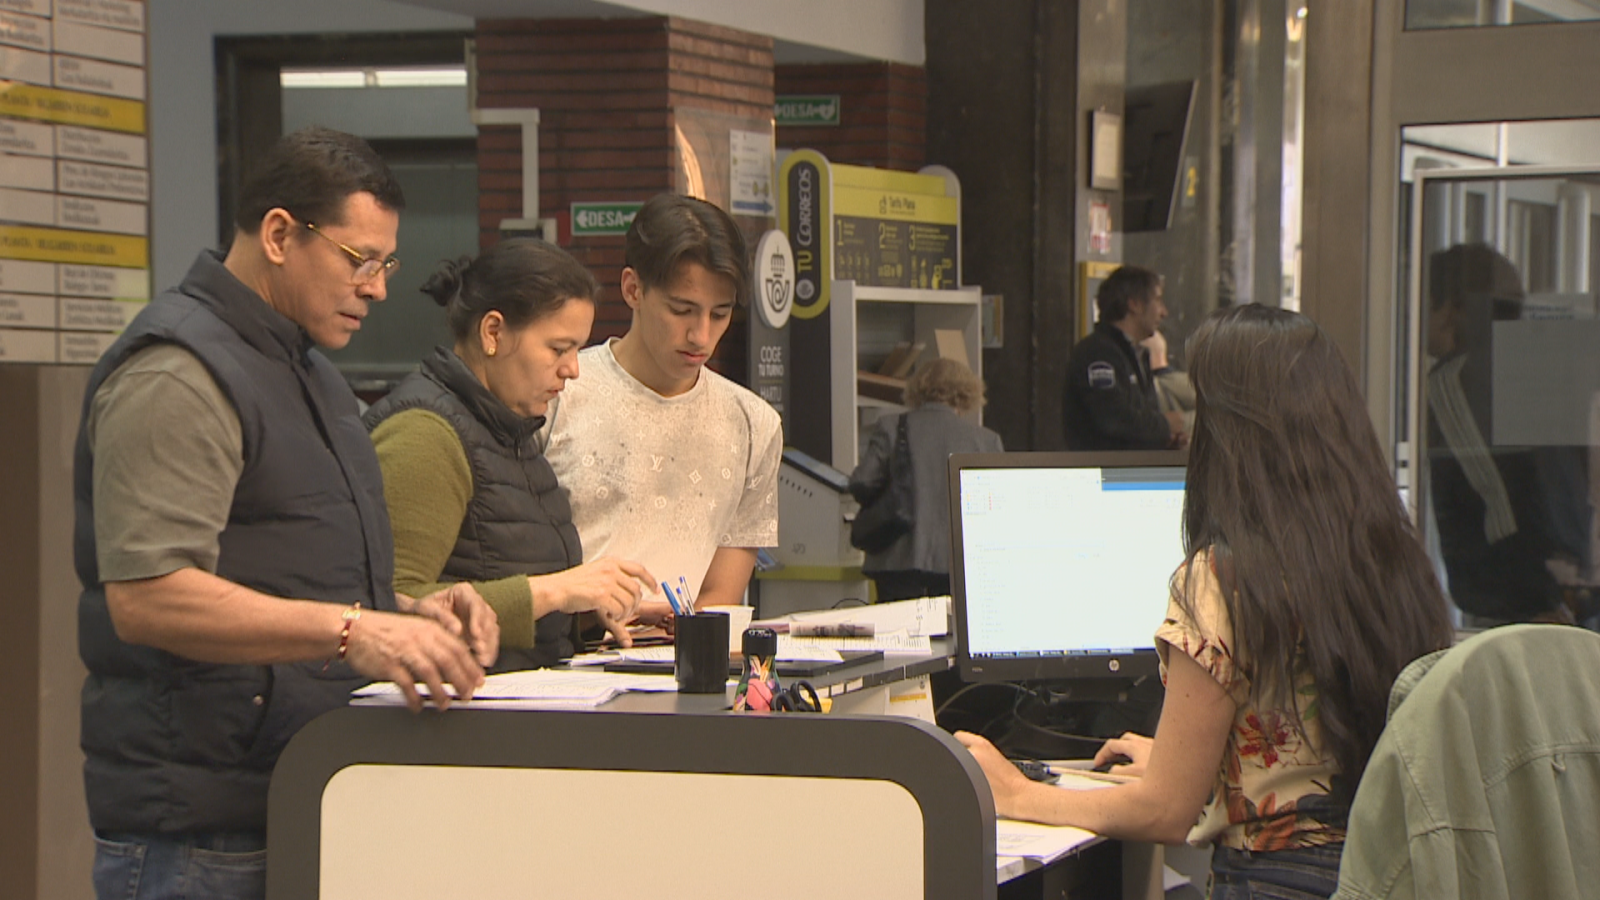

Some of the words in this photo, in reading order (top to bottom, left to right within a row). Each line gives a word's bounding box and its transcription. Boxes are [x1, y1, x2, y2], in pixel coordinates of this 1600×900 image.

[783, 101, 813, 120] DESA
[798, 168, 812, 246] CORREOS
[588, 212, 624, 226] DESA
[837, 219, 844, 246] 1
[879, 222, 886, 249] 2
[909, 225, 916, 251] 3
[797, 251, 813, 273] TU
[760, 345, 781, 362] COGE
[758, 364, 766, 377] TU
